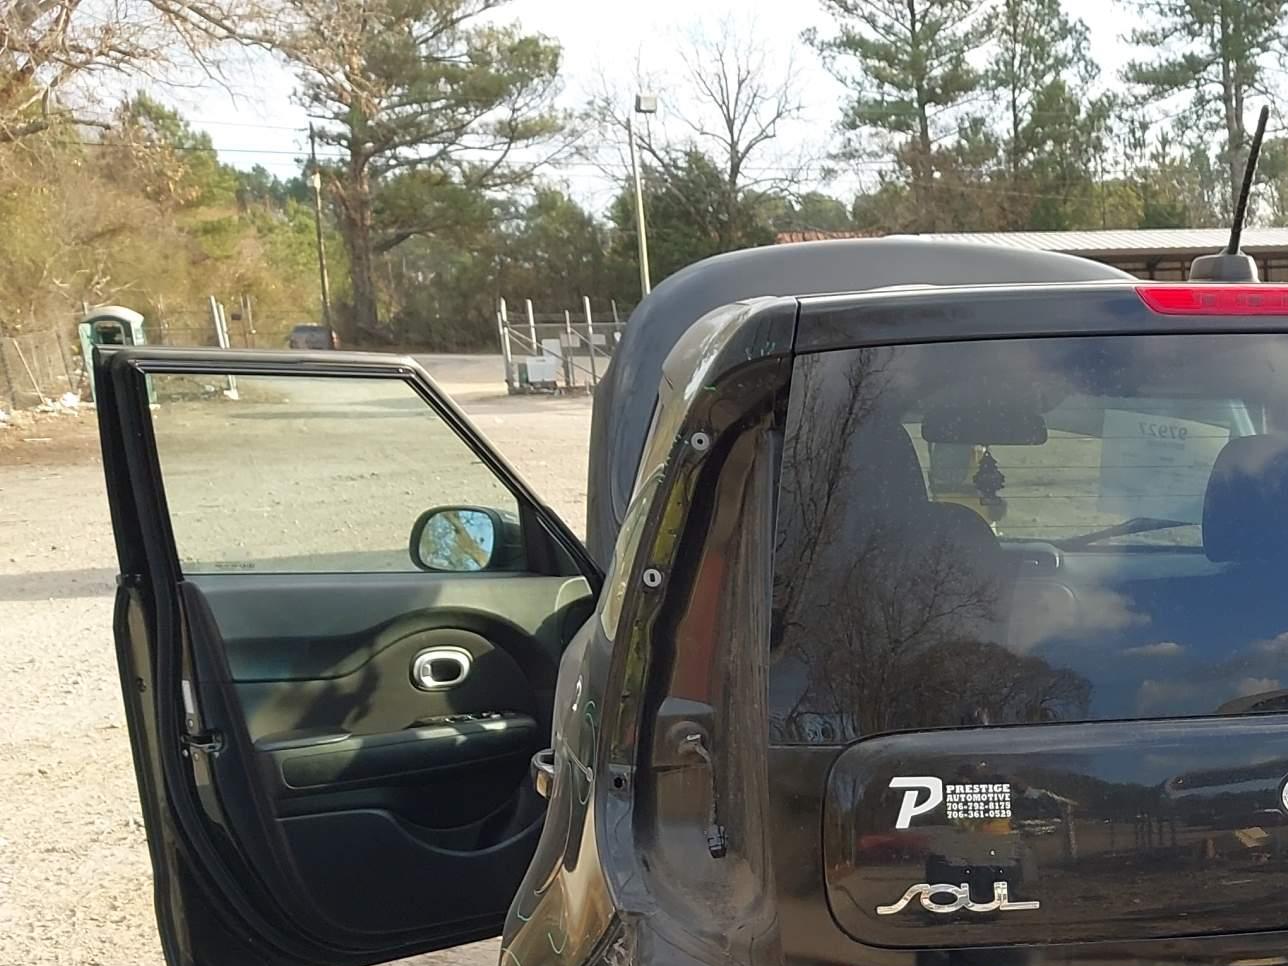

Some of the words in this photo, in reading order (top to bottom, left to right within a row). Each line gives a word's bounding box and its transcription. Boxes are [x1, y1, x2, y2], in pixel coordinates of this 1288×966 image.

[946, 784, 1010, 793] PRESTIGE
[946, 793, 1010, 802] AUTOMOTIVE
[889, 777, 943, 829] P
